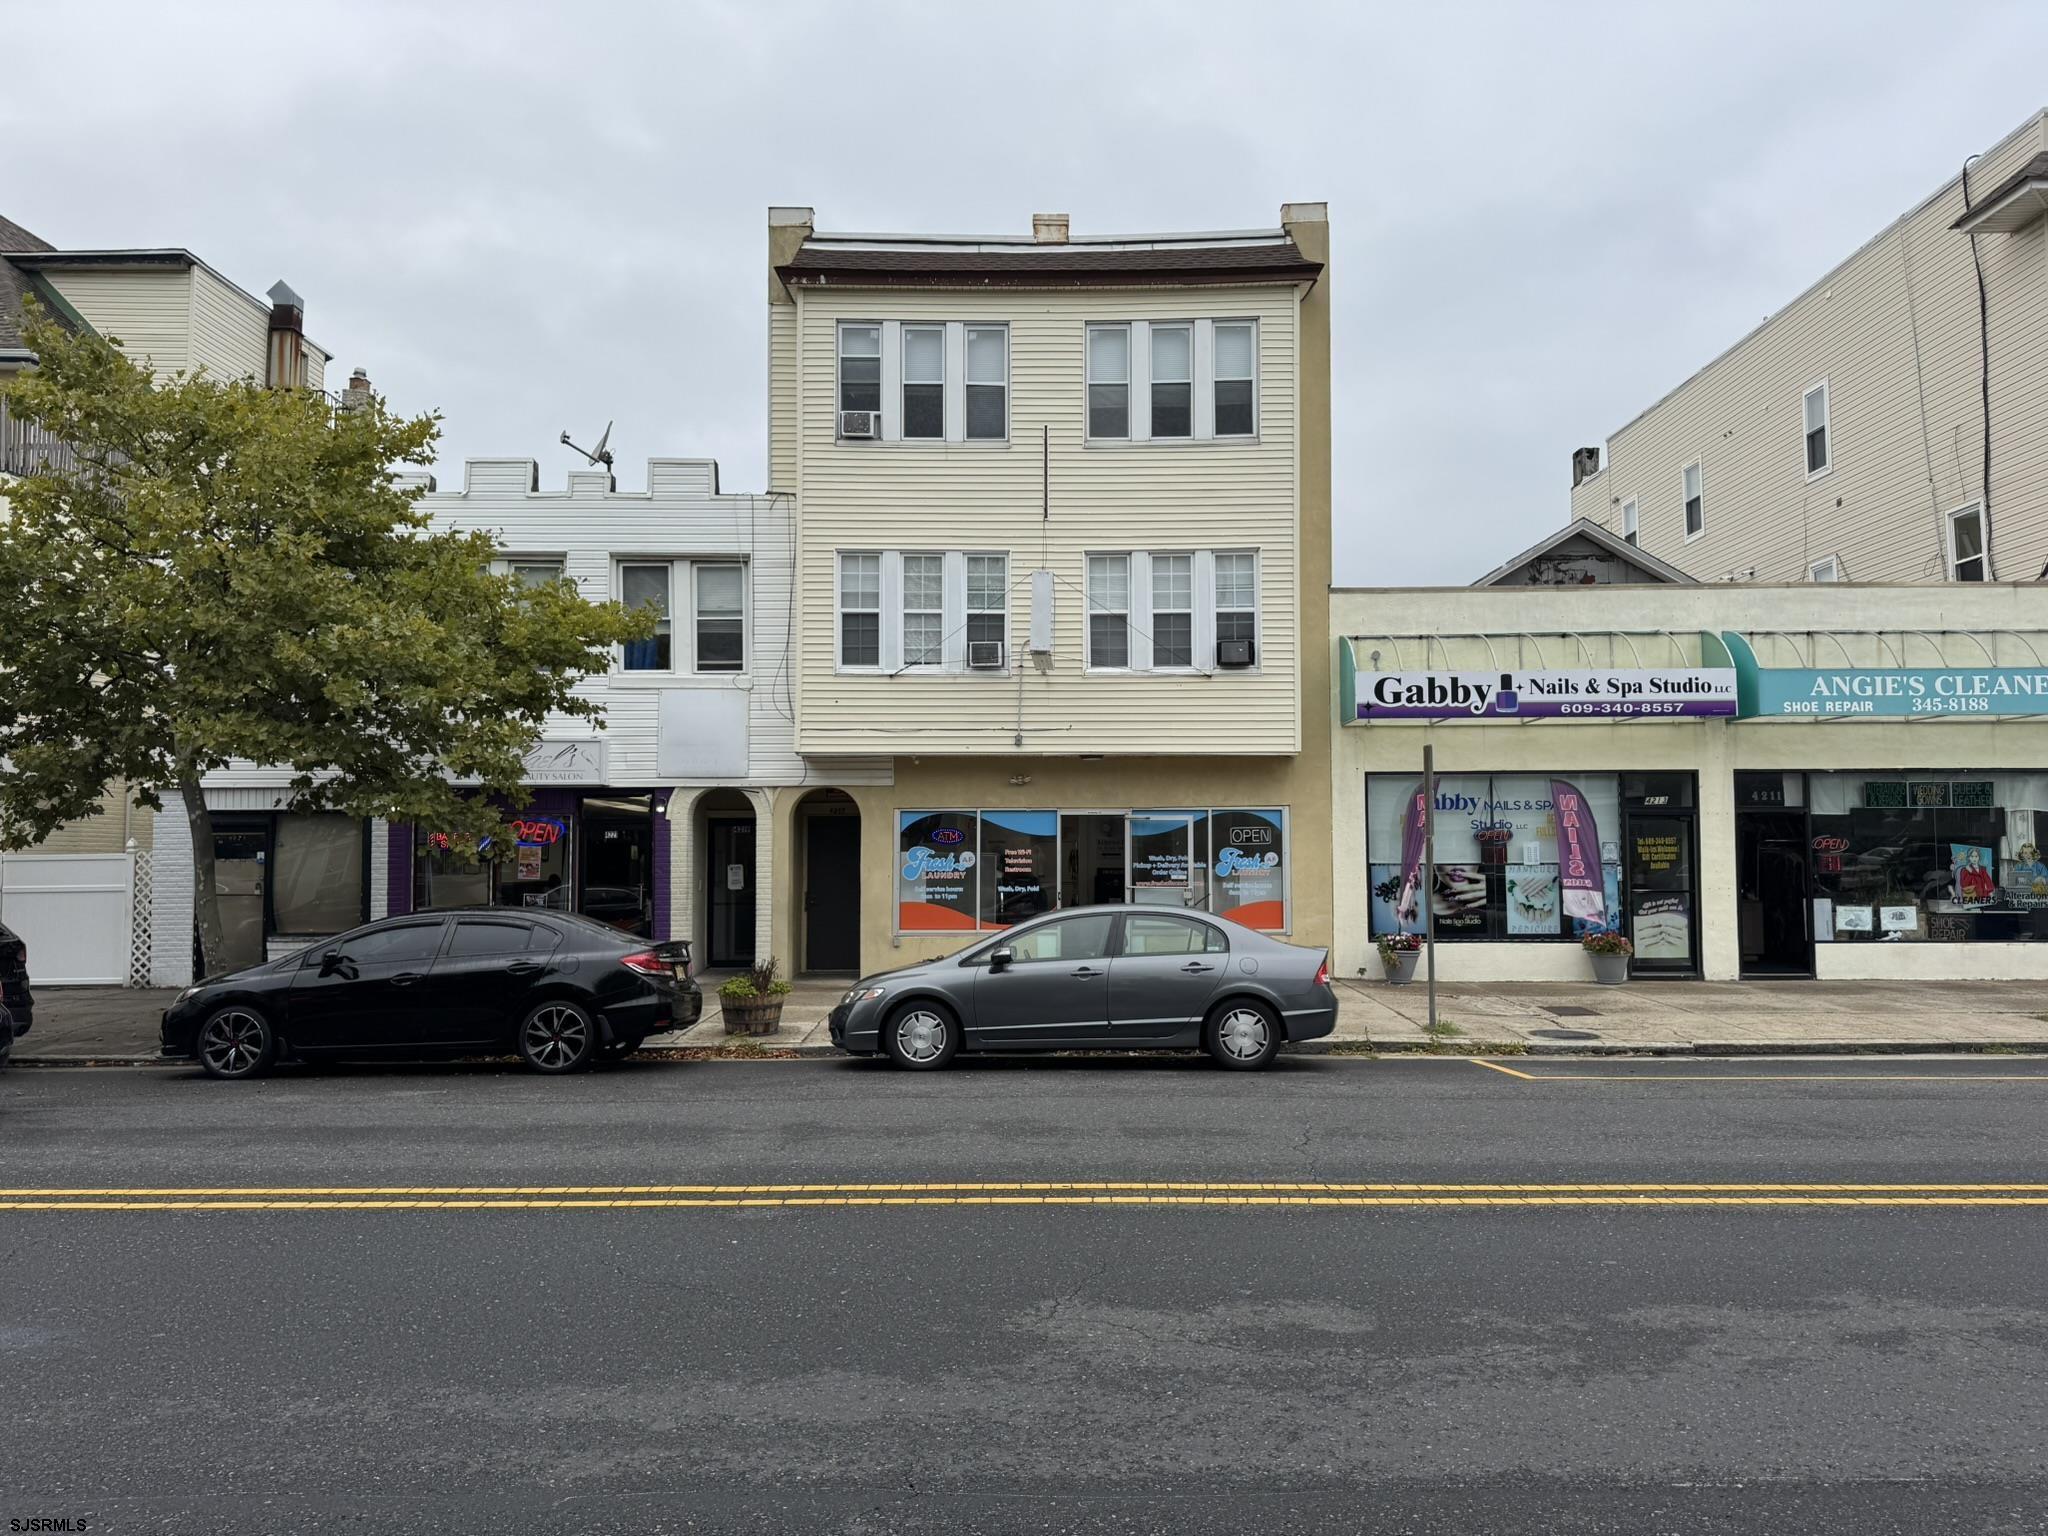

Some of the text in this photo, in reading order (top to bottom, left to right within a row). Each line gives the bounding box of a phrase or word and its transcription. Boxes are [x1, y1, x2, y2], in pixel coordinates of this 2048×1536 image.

[1810, 675, 1925, 697] ANGIE'S
[1374, 675, 1732, 712] Gabby Nails & Spa Studio LLC
[1561, 702, 1684, 715] 609-340-8557
[1783, 701, 1873, 713] SHOE REPAIR
[1912, 697, 1989, 711] 345-8188
[526, 772, 583, 780] AUTY SALON
[1952, 783, 1982, 794] SUEDE
[1752, 791, 1781, 800] 4211
[1954, 795, 1992, 806] LEATHER
[1484, 800, 1523, 811] NAILS
[1523, 800, 1533, 811] &
[1470, 819, 1513, 830] Studio
[511, 820, 560, 843] OPEN
[937, 832, 959, 842] ATM
[1231, 829, 1270, 843] OPEN
[1477, 830, 1511, 841] OPEN
[1813, 838, 1847, 850] OPEN
[902, 846, 957, 880] Fresh
[1215, 847, 1261, 877] Fresh
[921, 871, 967, 880] LAUNDRY
[1951, 896, 1998, 905] CLEANERS
[2008, 900, 2015, 909] &
[1511, 924, 1559, 933] PEDICURE
[1930, 917, 1956, 929] SHOE
[1931, 929, 1967, 941] REPAIR
